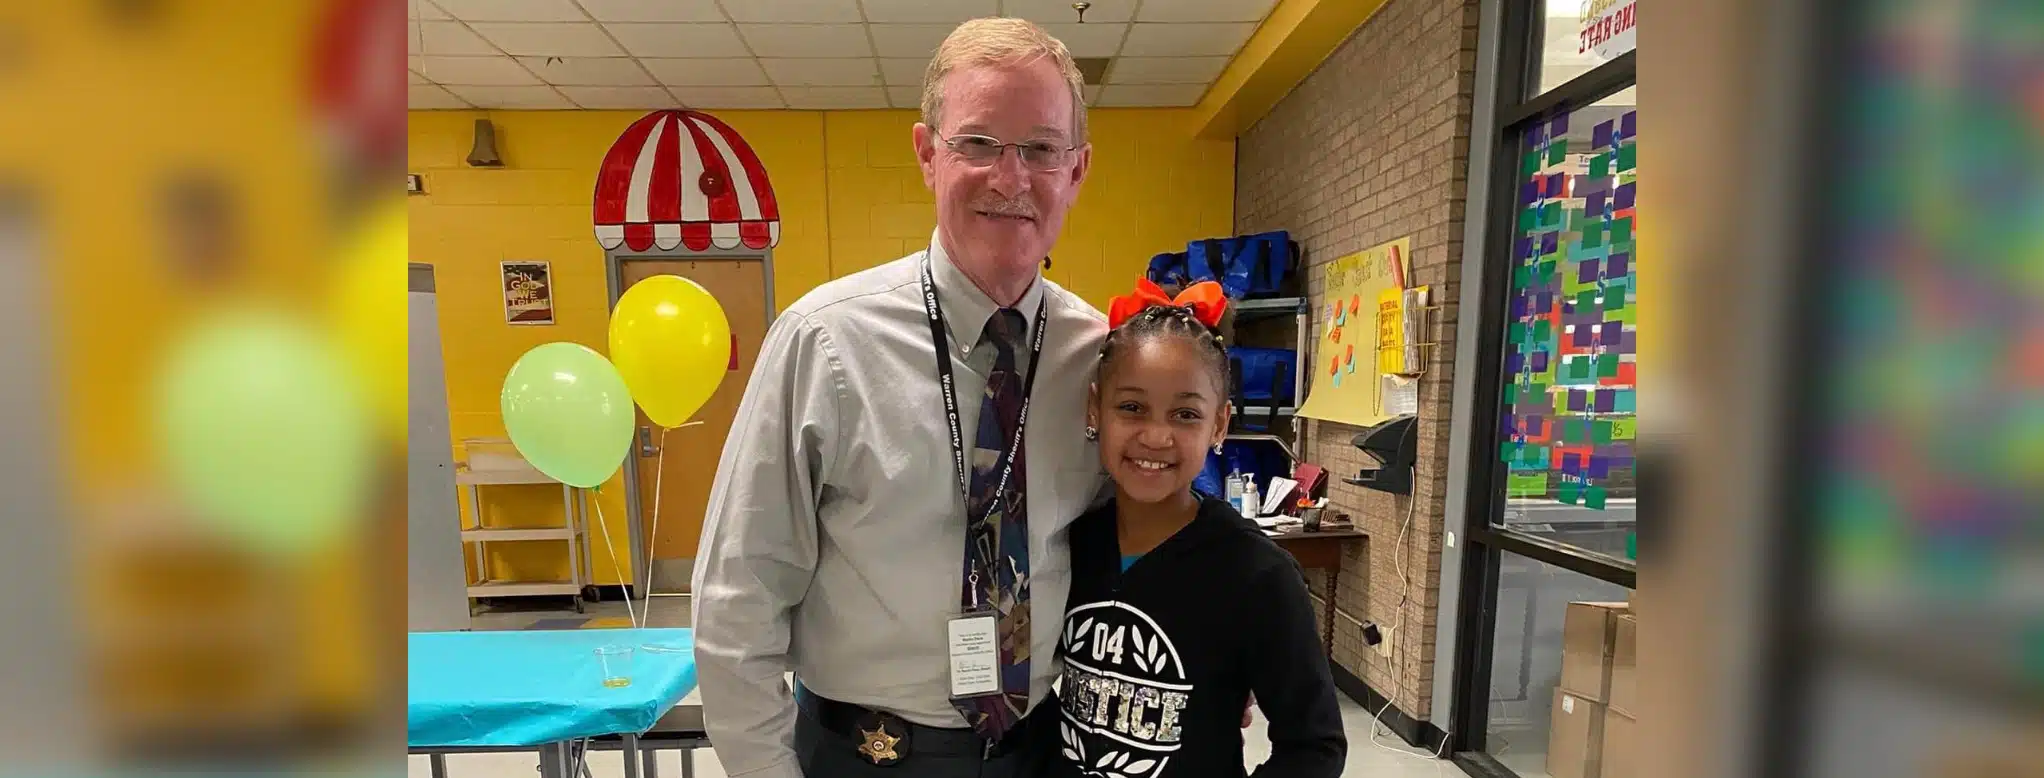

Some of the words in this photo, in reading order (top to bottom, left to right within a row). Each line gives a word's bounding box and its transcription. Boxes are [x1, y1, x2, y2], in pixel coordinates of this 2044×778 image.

[511, 280, 538, 290] GOD
[520, 272, 533, 281] IN
[516, 290, 538, 299] WE
[926, 292, 938, 320] Office
[1034, 320, 1045, 352] Warren
[942, 374, 954, 410] Warren
[949, 412, 960, 448] County
[995, 465, 1012, 498] County
[1007, 427, 1023, 463] Sheriff's
[1019, 398, 1029, 425] Office
[1092, 622, 1126, 665] 04
[1060, 664, 1189, 742] USTICE
